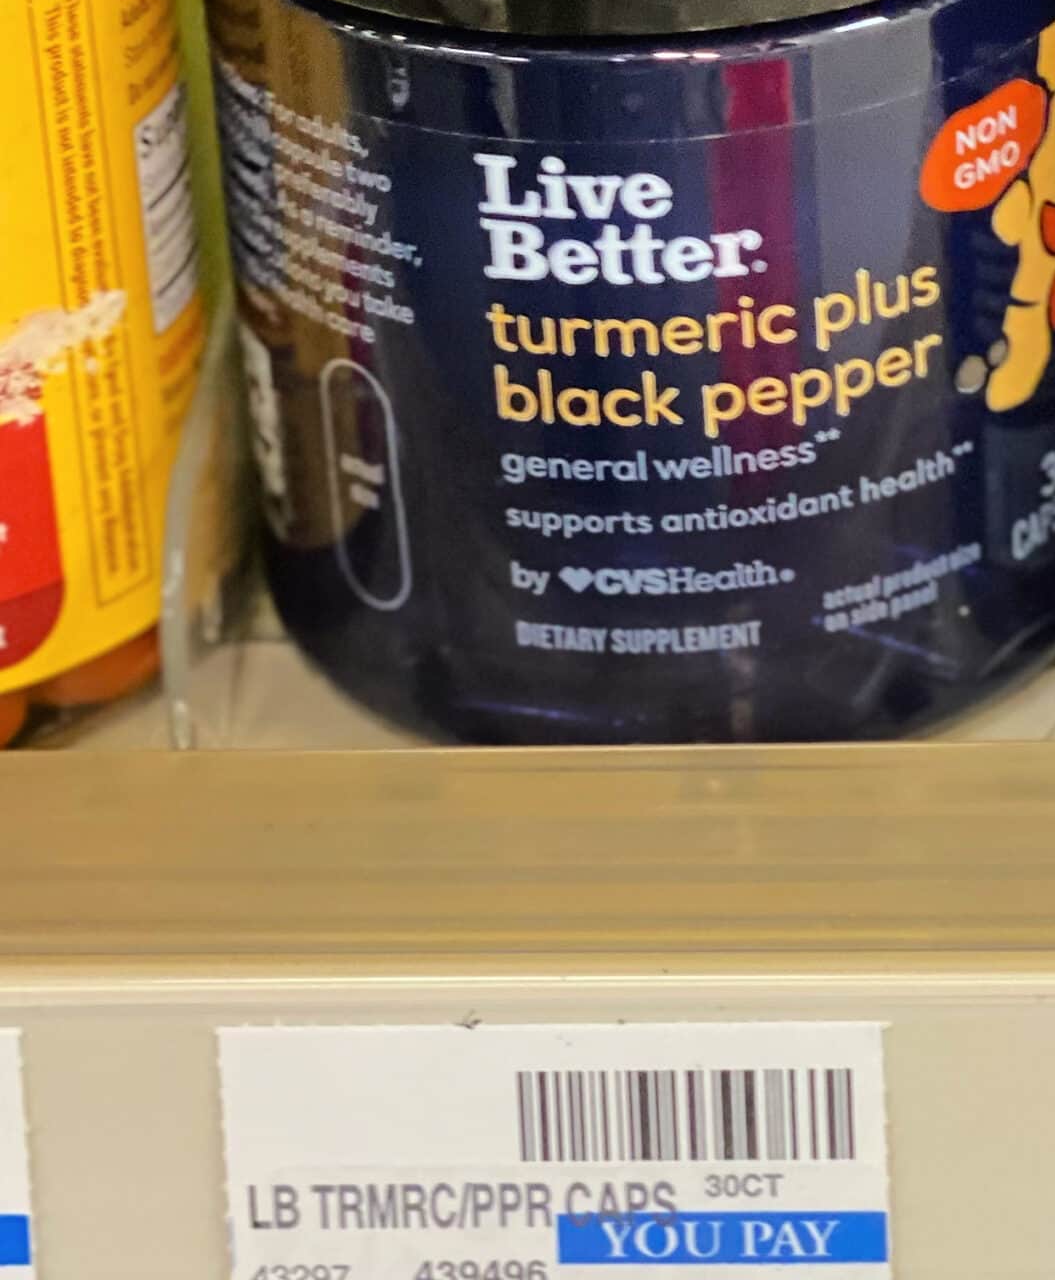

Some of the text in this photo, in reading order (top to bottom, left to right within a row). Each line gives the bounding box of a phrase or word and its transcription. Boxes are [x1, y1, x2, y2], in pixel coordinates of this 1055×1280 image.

[44, 45, 69, 107] product
[58, 127, 74, 152] not
[955, 104, 1017, 156] NON
[473, 152, 673, 220] Live
[954, 140, 1020, 189] GMO
[485, 266, 941, 358] turmeric plus
[494, 333, 943, 439] black pepper
[501, 450, 648, 483] general
[505, 507, 653, 538] supports
[660, 486, 853, 534] antioxidant
[509, 560, 549, 595] by
[516, 620, 762, 654] DIETARY SUPPLEMENT
[247, 1173, 784, 1230] LB TRMRC/PPR CAPS 30CT
[600, 1220, 840, 1259] YOU PAY
